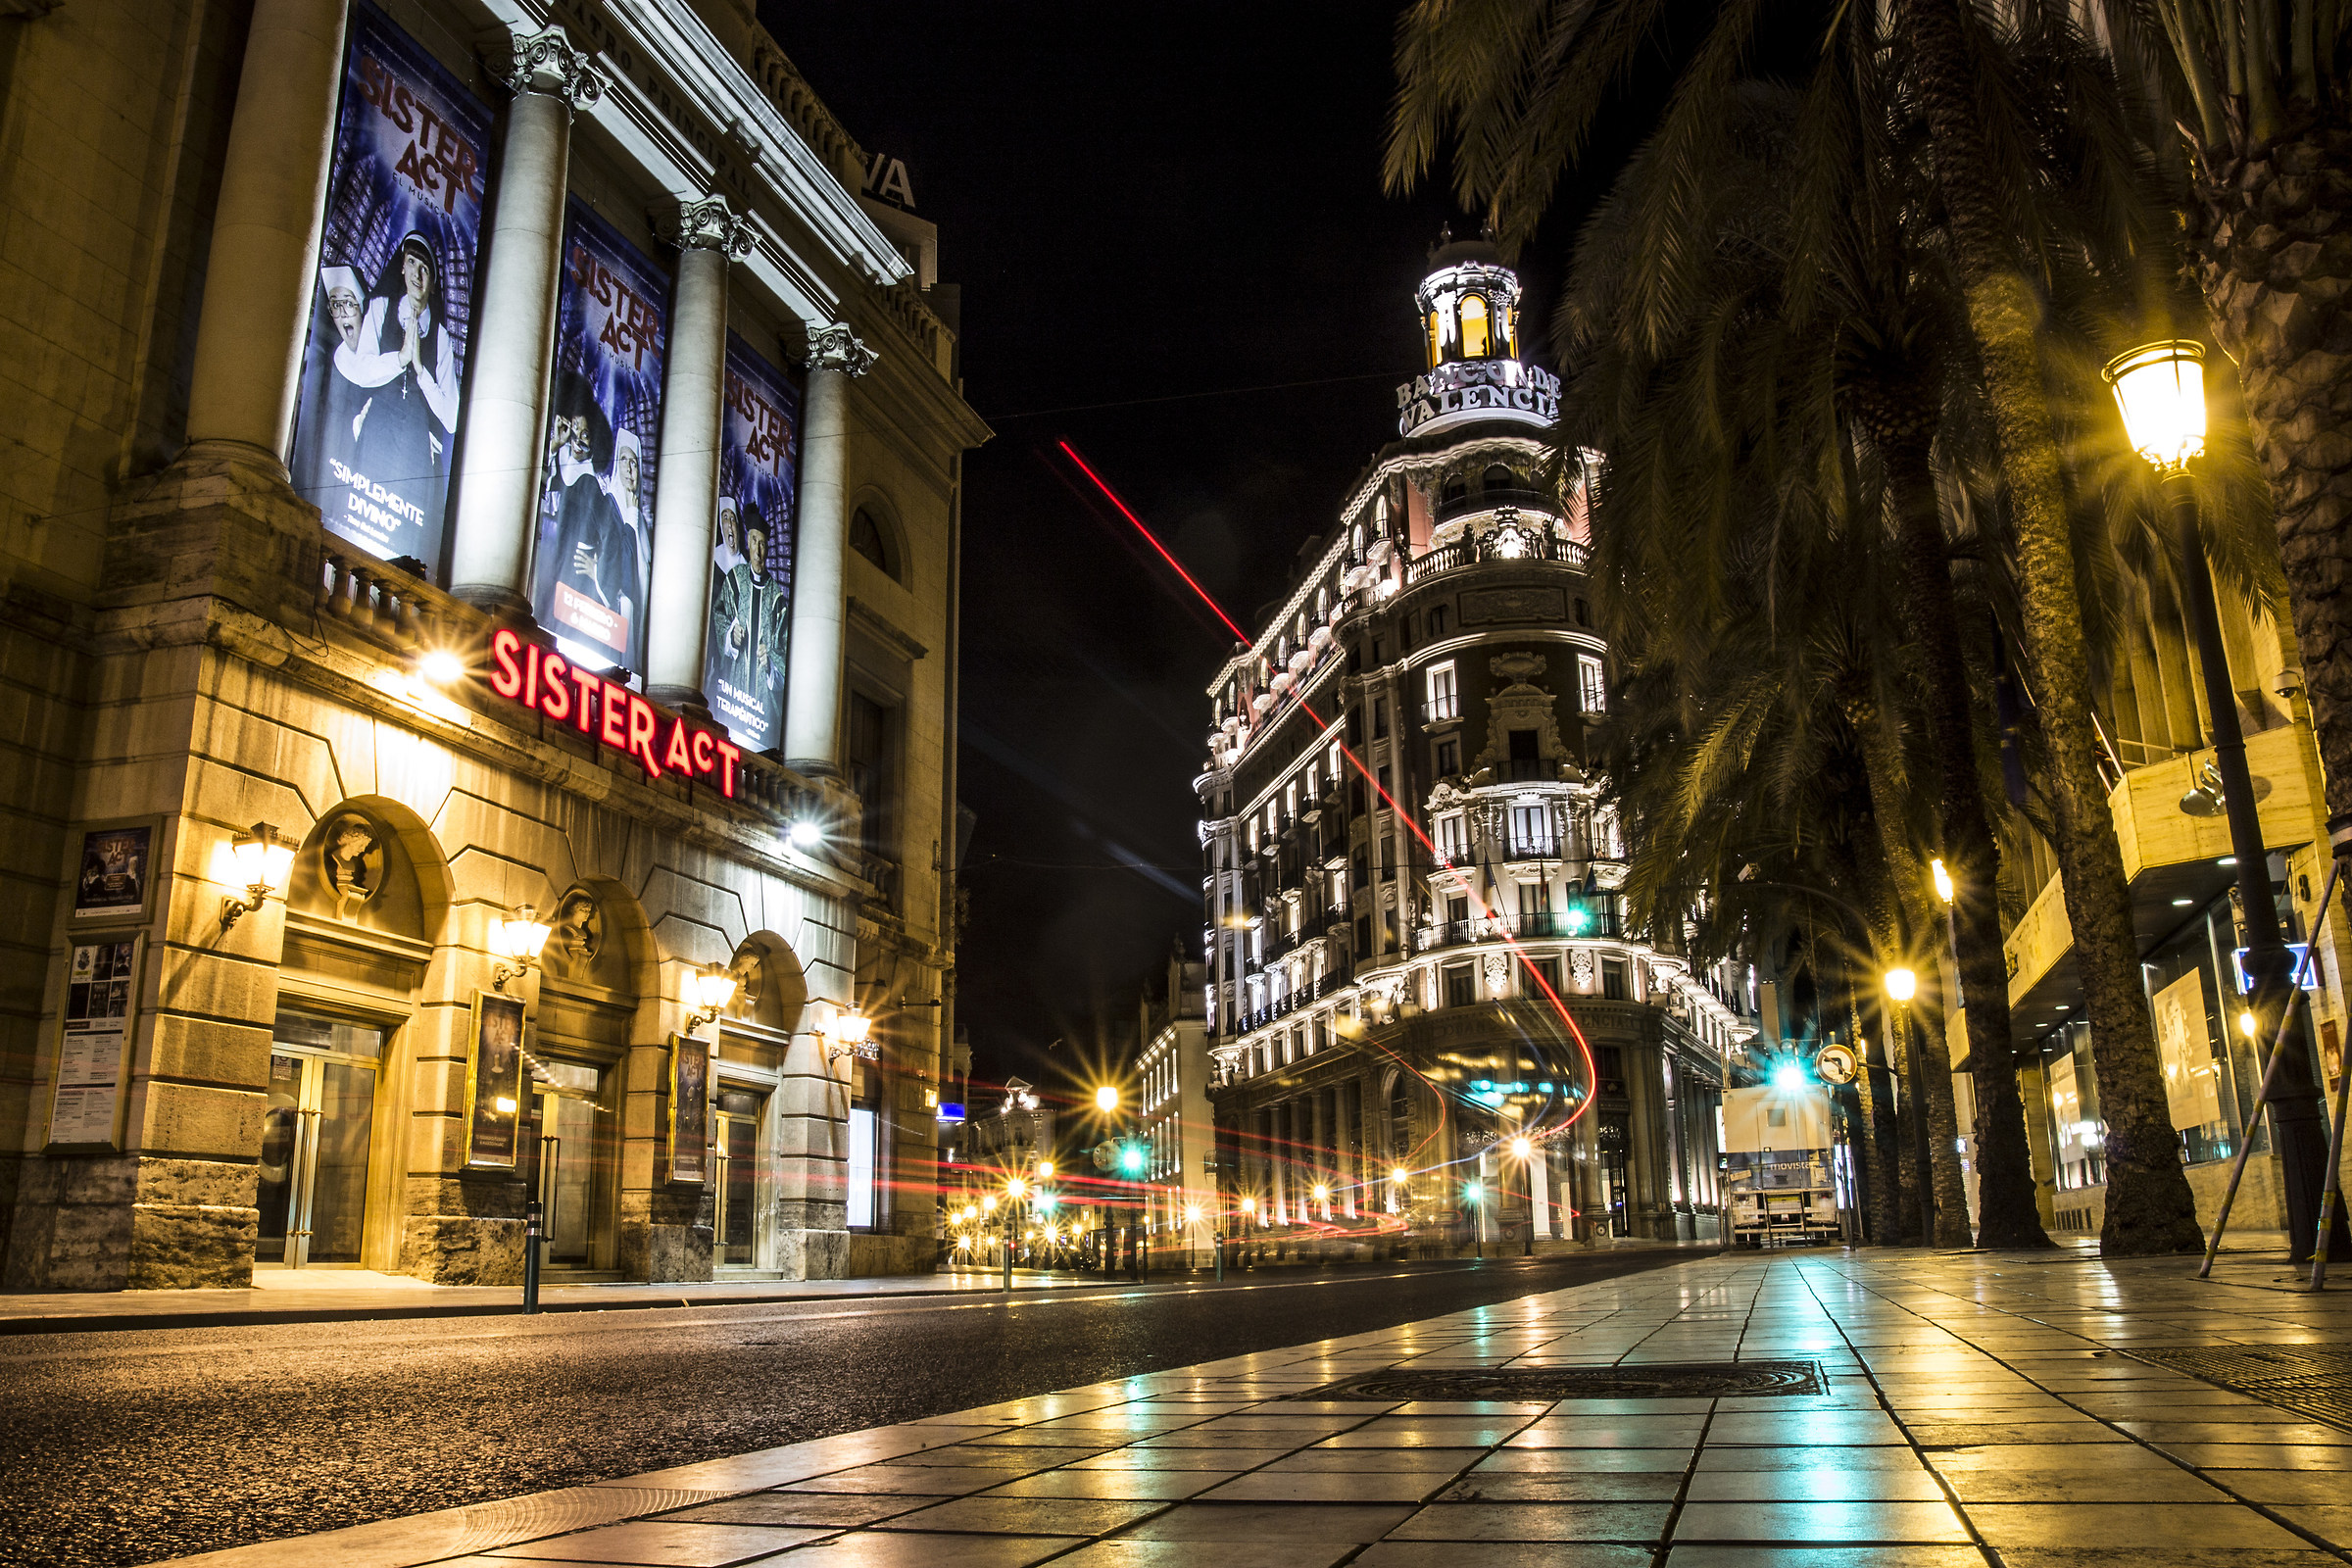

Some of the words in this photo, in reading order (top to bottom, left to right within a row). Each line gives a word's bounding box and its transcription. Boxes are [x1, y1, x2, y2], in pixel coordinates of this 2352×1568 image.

[357, 55, 478, 203] SISTER
[647, 75, 752, 199] PRINCIPAL
[392, 172, 403, 187] EL
[408, 185, 452, 225] MUSICAL
[394, 139, 465, 216] ACT
[570, 246, 660, 359] SISTER
[600, 312, 649, 372] ACT
[1396, 360, 1504, 409] BANCO
[1532, 365, 1561, 400] DE
[1399, 385, 1558, 429] VALENCIA
[725, 369, 793, 464] SISTER
[745, 425, 784, 478] ACT
[490, 629, 662, 779] SISTER
[664, 717, 740, 799] ACT
[733, 686, 764, 715] MUSICAL
[2299, 874, 2312, 903] 8
[1770, 1161, 1811, 1171] movista
